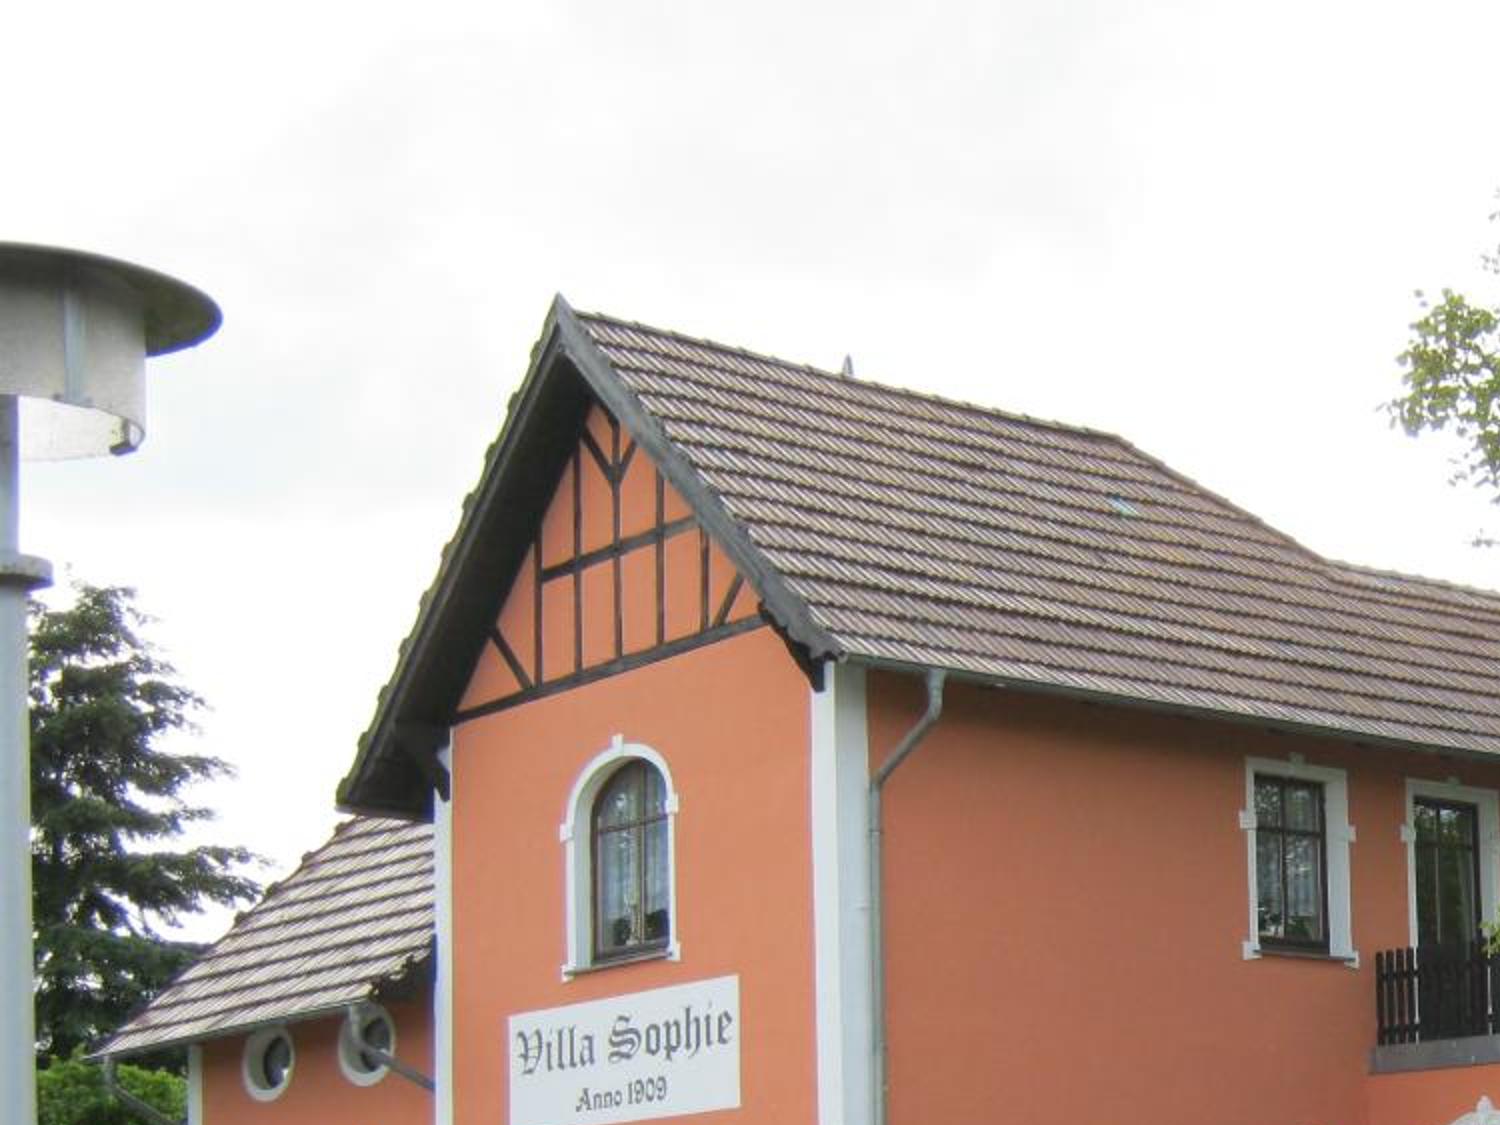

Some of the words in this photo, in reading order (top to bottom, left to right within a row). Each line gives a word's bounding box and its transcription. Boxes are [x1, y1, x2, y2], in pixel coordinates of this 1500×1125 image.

[517, 1024, 595, 1075] Villa
[608, 1000, 733, 1065] Sophie
[576, 1087, 623, 1113] Anno
[628, 1076, 667, 1105] 1909
